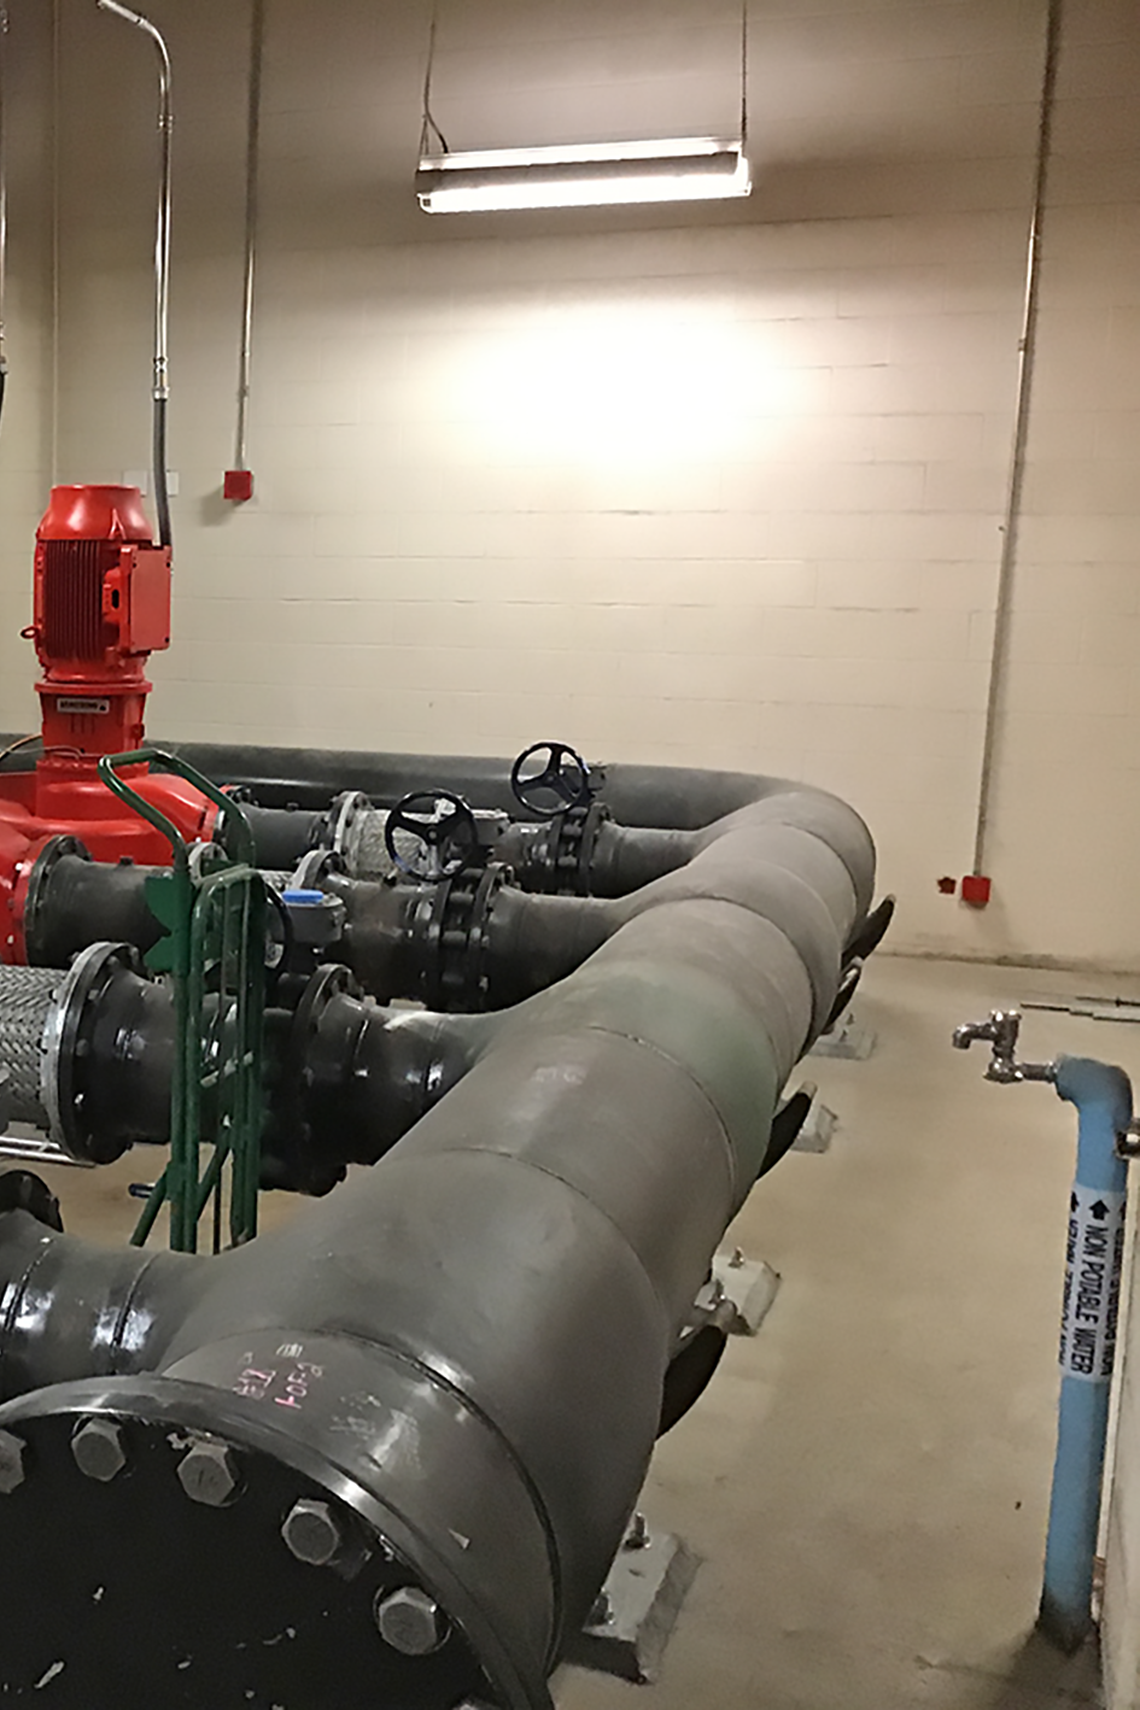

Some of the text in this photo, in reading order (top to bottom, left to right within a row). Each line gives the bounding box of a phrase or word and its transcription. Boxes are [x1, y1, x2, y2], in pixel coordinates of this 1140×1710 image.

[1071, 1224, 1108, 1375] NON POTABLE WATER
